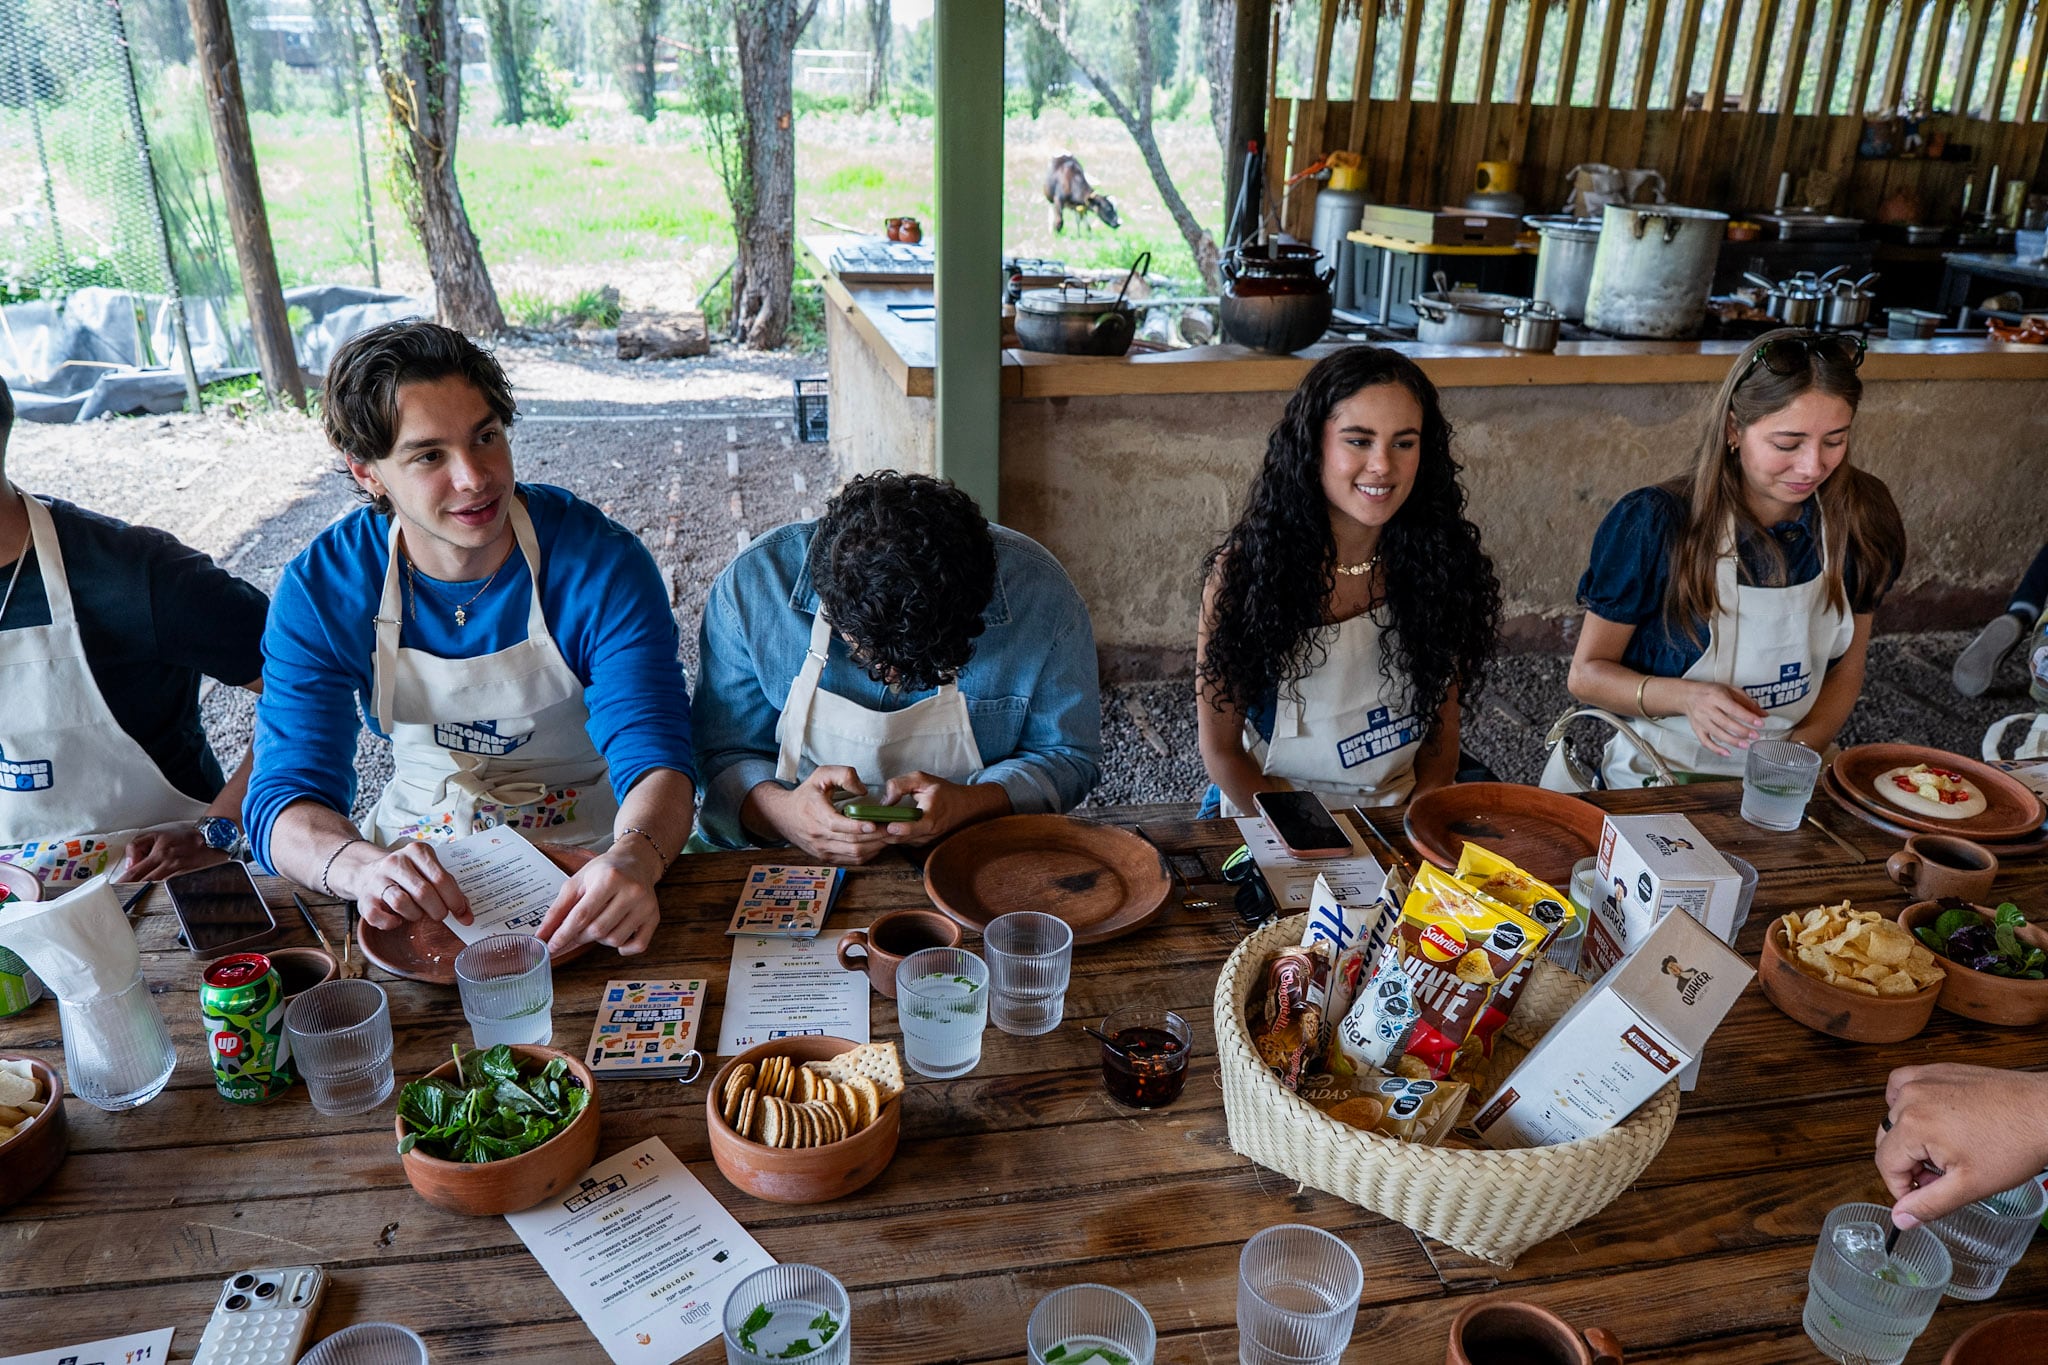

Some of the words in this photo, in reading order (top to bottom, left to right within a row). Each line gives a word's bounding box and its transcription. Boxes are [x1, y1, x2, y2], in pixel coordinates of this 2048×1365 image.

[437, 730, 464, 750] DEL
[1343, 745, 1370, 766] DEL
[1646, 833, 1672, 856] QUAKER
[1601, 901, 1627, 941] QUAKER
[1421, 926, 1467, 955] Sabritas
[1681, 971, 1712, 1006] QUAKER
[1301, 1089, 1351, 1101] RADAS
[568, 1197, 589, 1212] DEL
[602, 1207, 625, 1222] MENÚ
[651, 1271, 695, 1298] MIXOLOGÍA
